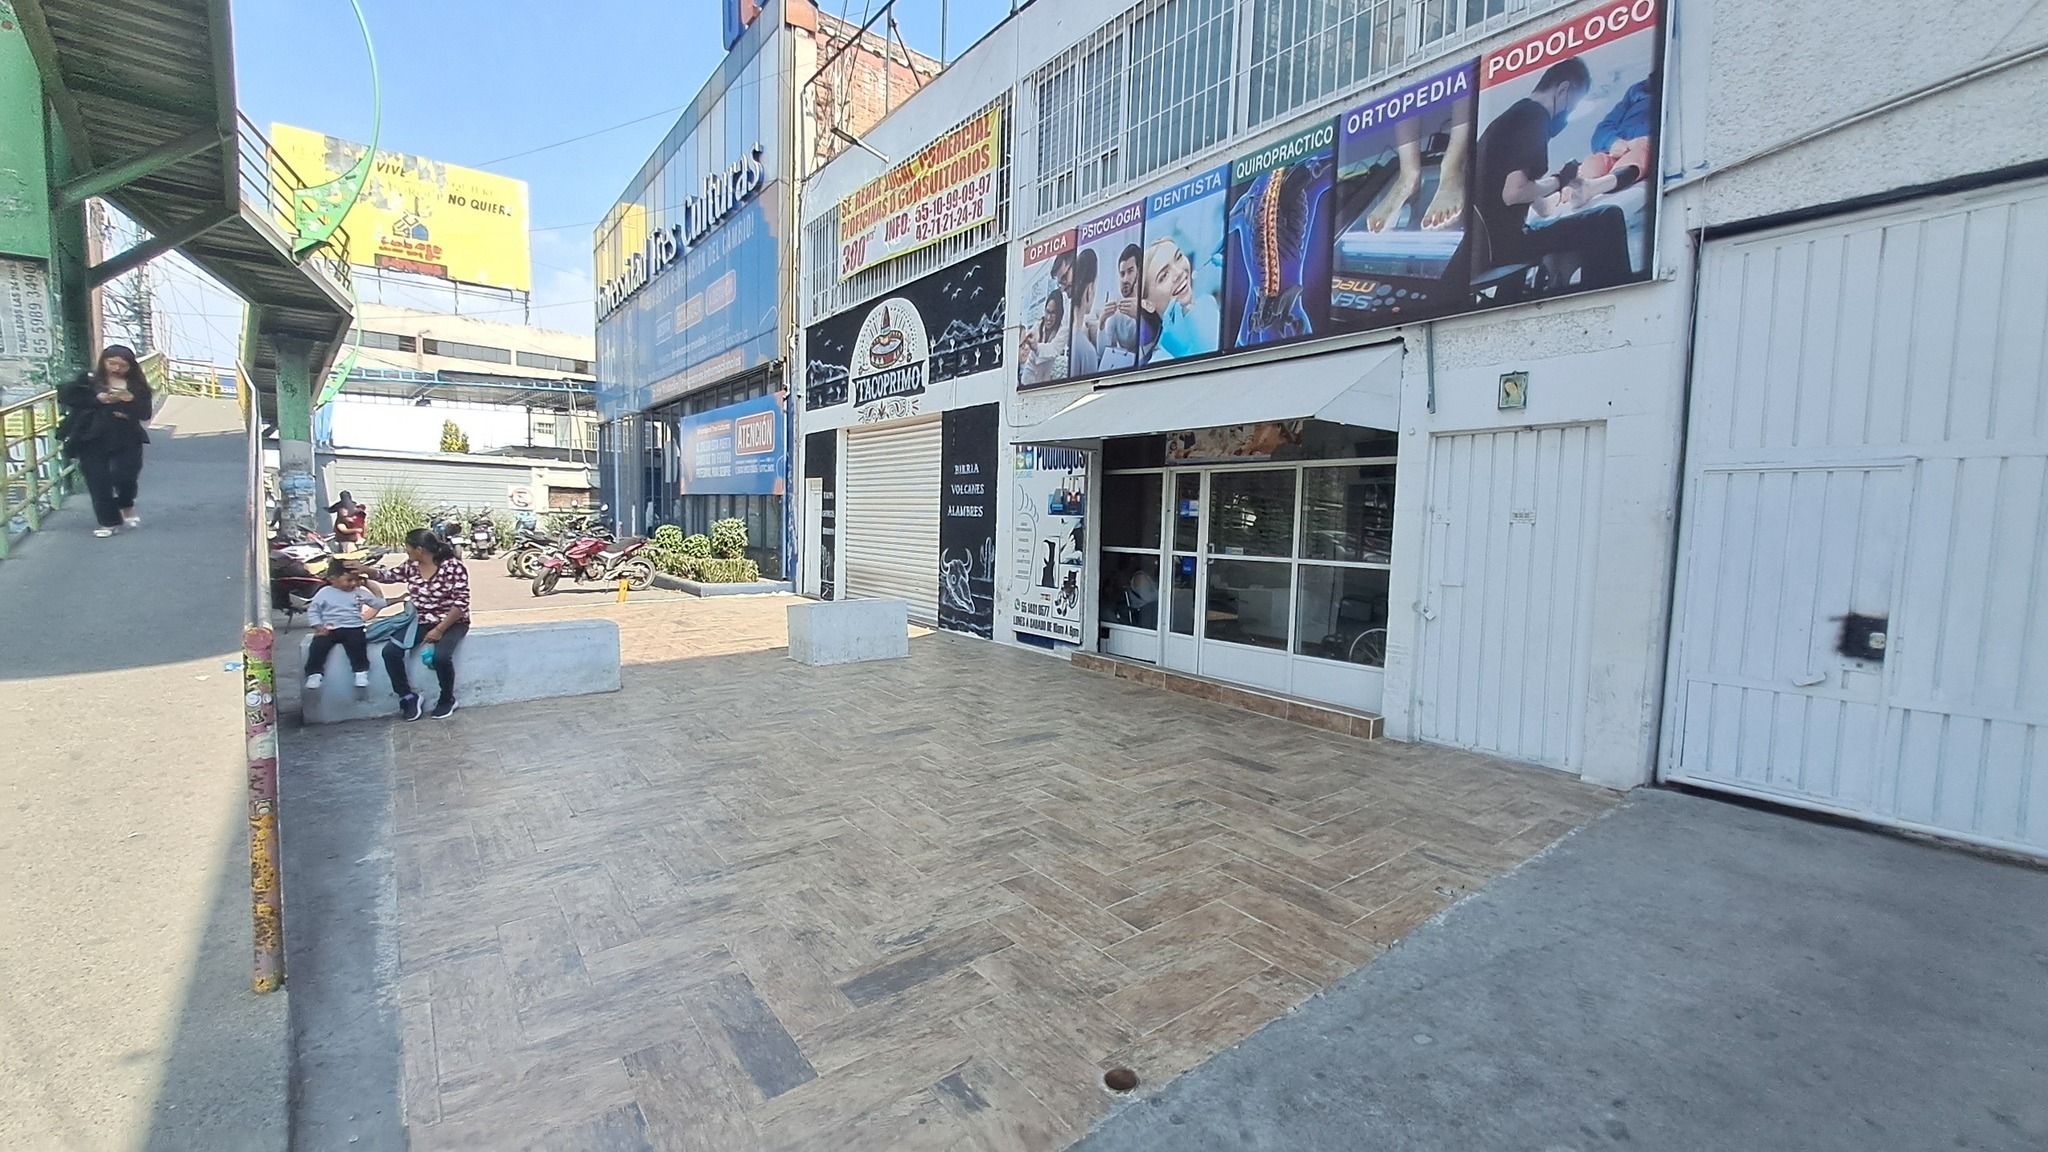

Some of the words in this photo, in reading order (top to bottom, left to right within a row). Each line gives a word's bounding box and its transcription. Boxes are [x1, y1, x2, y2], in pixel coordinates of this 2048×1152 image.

[1488, 0, 1654, 79] PODOLOGO
[1347, 71, 1468, 134] ORTOPEDIA
[1236, 125, 1334, 179] QUIROPRACTICO
[683, 142, 762, 247] Culturas
[898, 143, 990, 210] CONSULTORIOS
[1153, 173, 1222, 213] DENTISTA
[448, 194, 466, 207] NO
[470, 199, 512, 217] QUIER
[841, 196, 852, 219] SE
[855, 177, 882, 211] RENTA
[1081, 204, 1142, 239] PSICOLOGIA
[1029, 236, 1068, 261] OPTICA
[856, 365, 921, 402] TACOPRIMO
[738, 415, 773, 449] ATENCIÓN
[950, 483, 985, 495] VOLCANES
[947, 505, 984, 518] ALAMBRES
